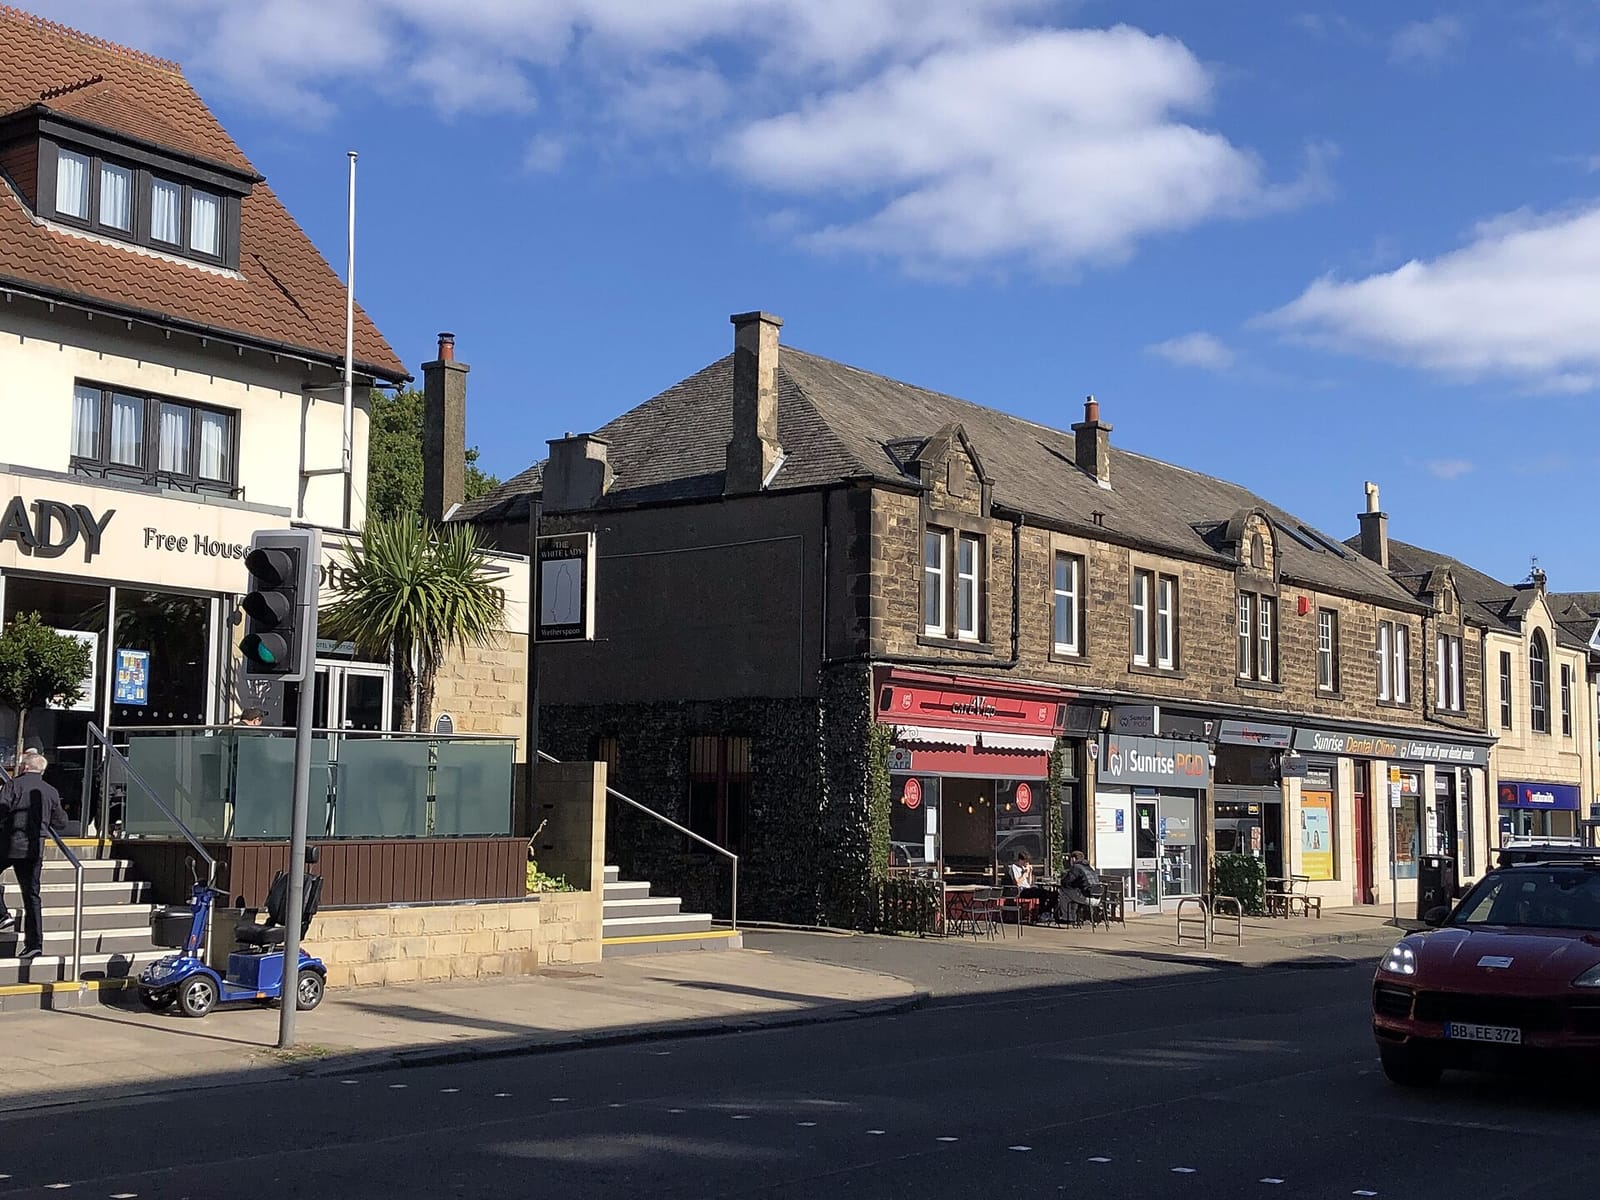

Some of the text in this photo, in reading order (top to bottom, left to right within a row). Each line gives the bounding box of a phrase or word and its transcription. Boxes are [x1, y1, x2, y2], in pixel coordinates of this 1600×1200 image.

[143, 527, 188, 552] Free
[555, 540, 569, 550] THE
[541, 547, 582, 558] WHITE LADY
[541, 627, 581, 638] Wetherspoon
[1129, 713, 1152, 722] Sunrise
[1312, 732, 1344, 752] Sunrise
[1345, 736, 1373, 754] Dental
[1375, 738, 1397, 755] Clinic
[1410, 742, 1425, 759] Caring
[1130, 749, 1204, 777] Sunrise POD
[1451, 1024, 1520, 1043] BB EE 372
